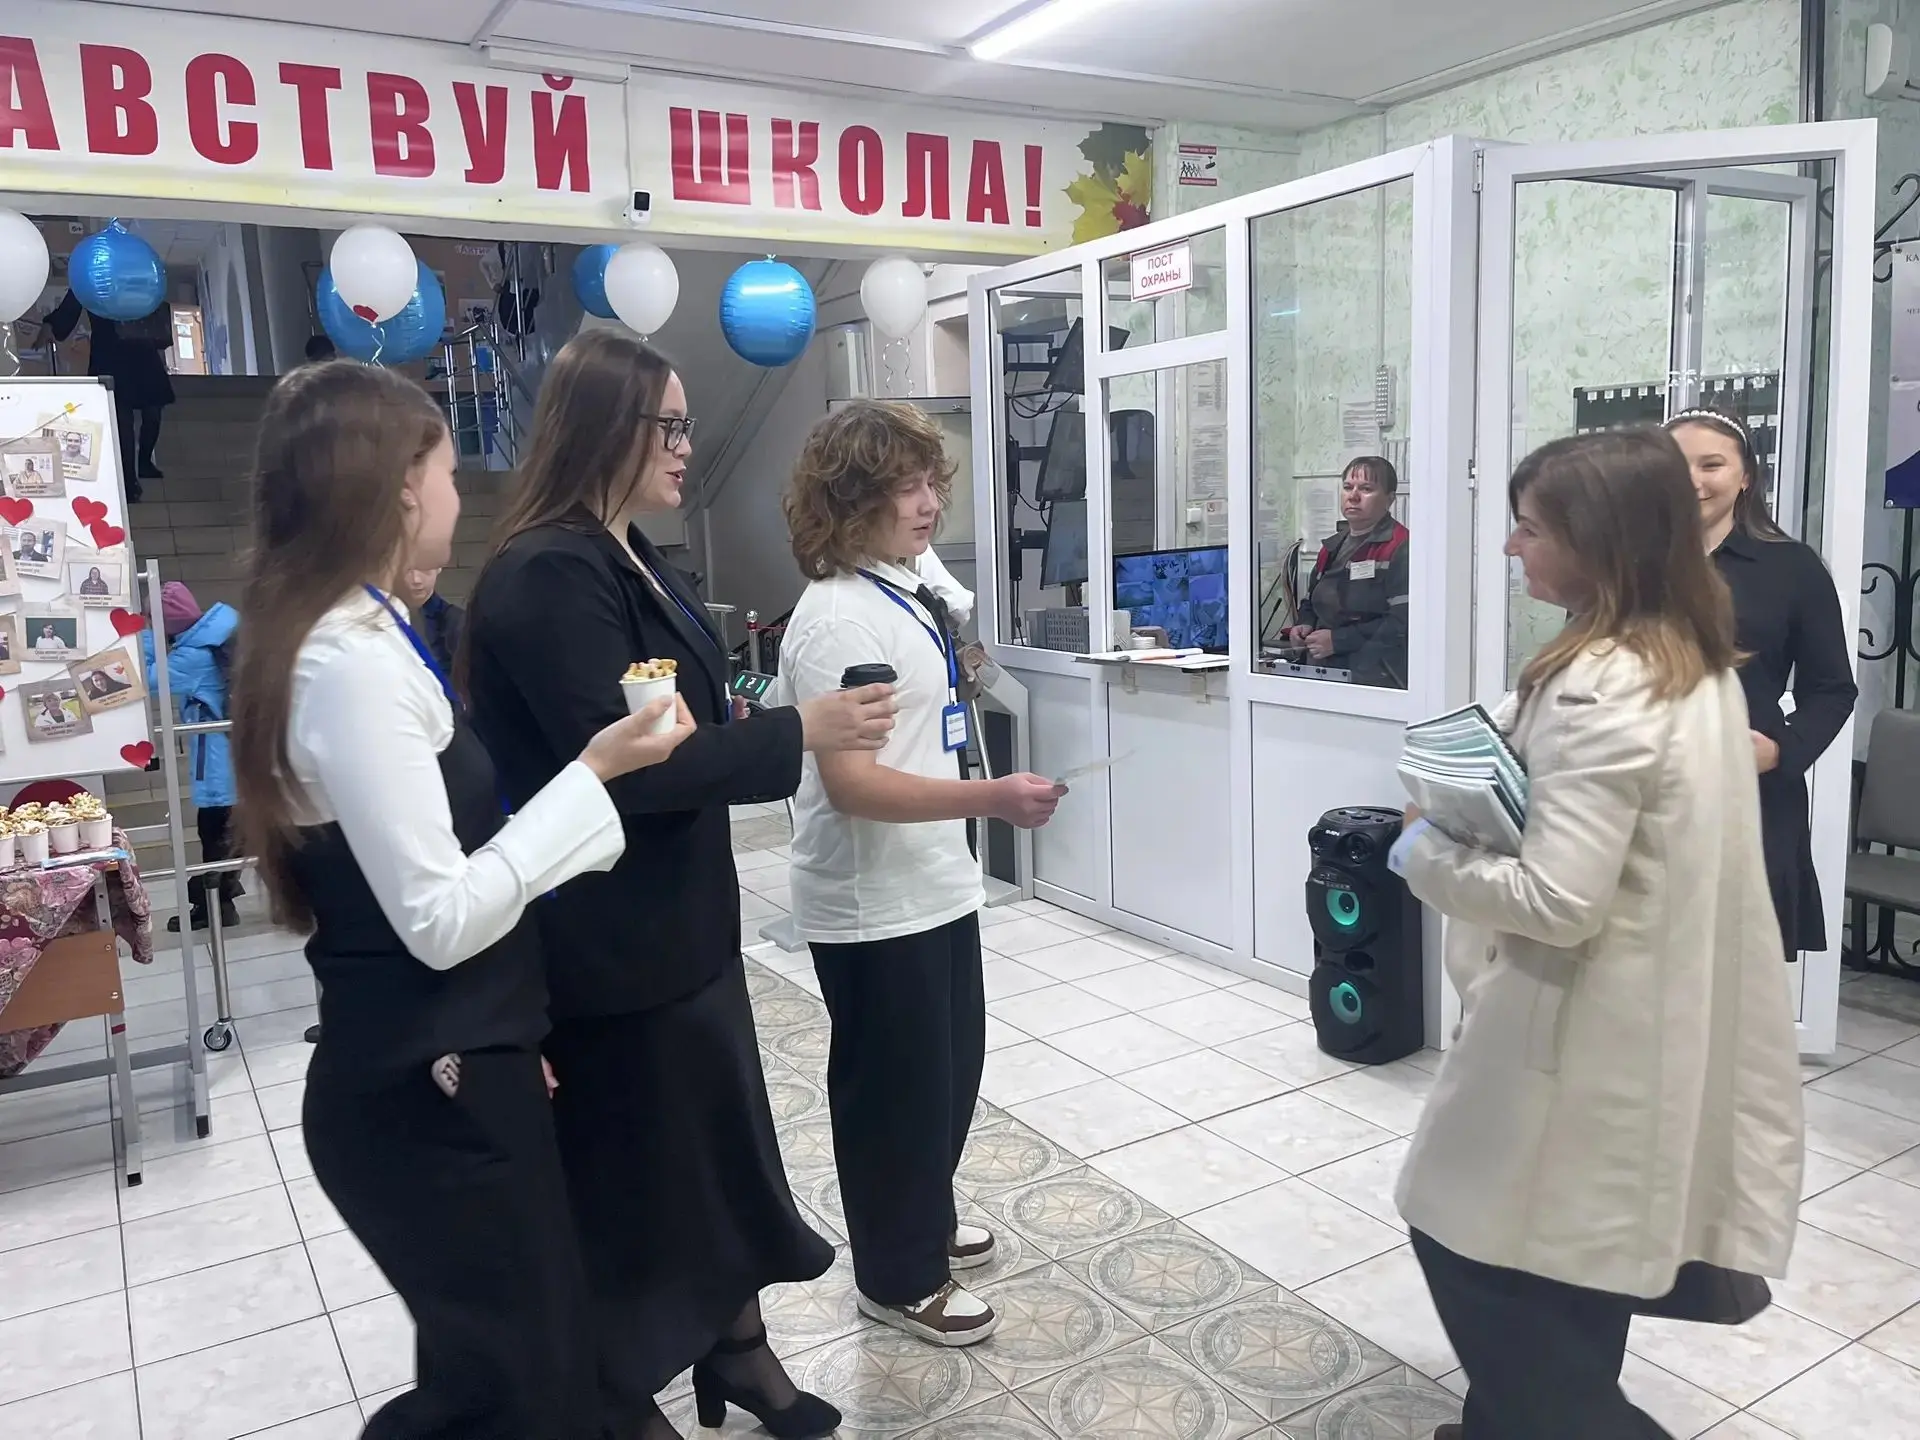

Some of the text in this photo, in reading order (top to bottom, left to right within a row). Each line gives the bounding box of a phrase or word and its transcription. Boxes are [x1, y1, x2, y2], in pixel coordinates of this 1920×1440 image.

[0, 36, 1043, 227] АВСТВУЙ ШКОЛА!
[1147, 253, 1174, 270] ПОСТ
[1141, 267, 1181, 288] ОХРАНЫ
